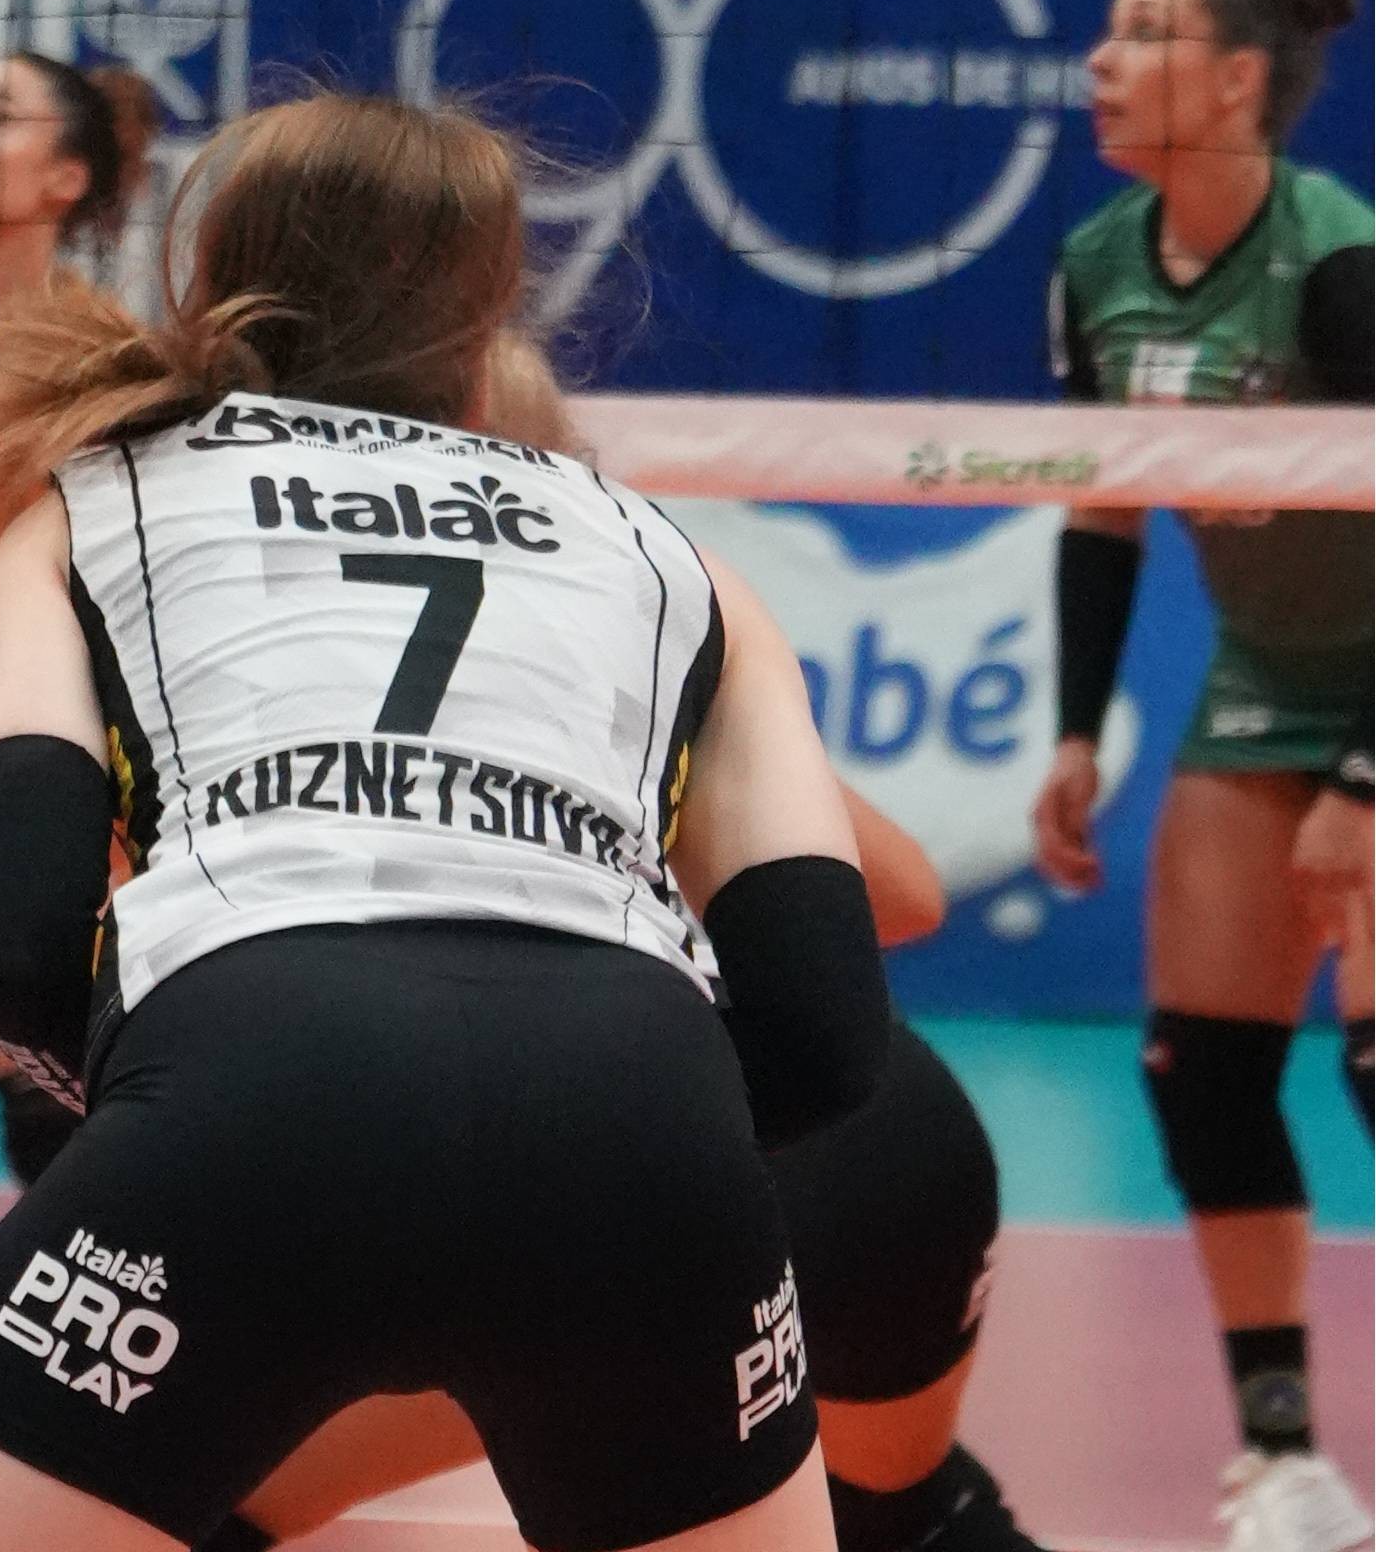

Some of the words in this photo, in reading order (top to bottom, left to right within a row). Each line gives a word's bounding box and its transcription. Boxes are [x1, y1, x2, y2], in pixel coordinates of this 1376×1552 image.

[251, 475, 561, 554] Italac
[339, 553, 486, 736] 7
[9, 1249, 181, 1376] PRO
[65, 1227, 169, 1303] Italac
